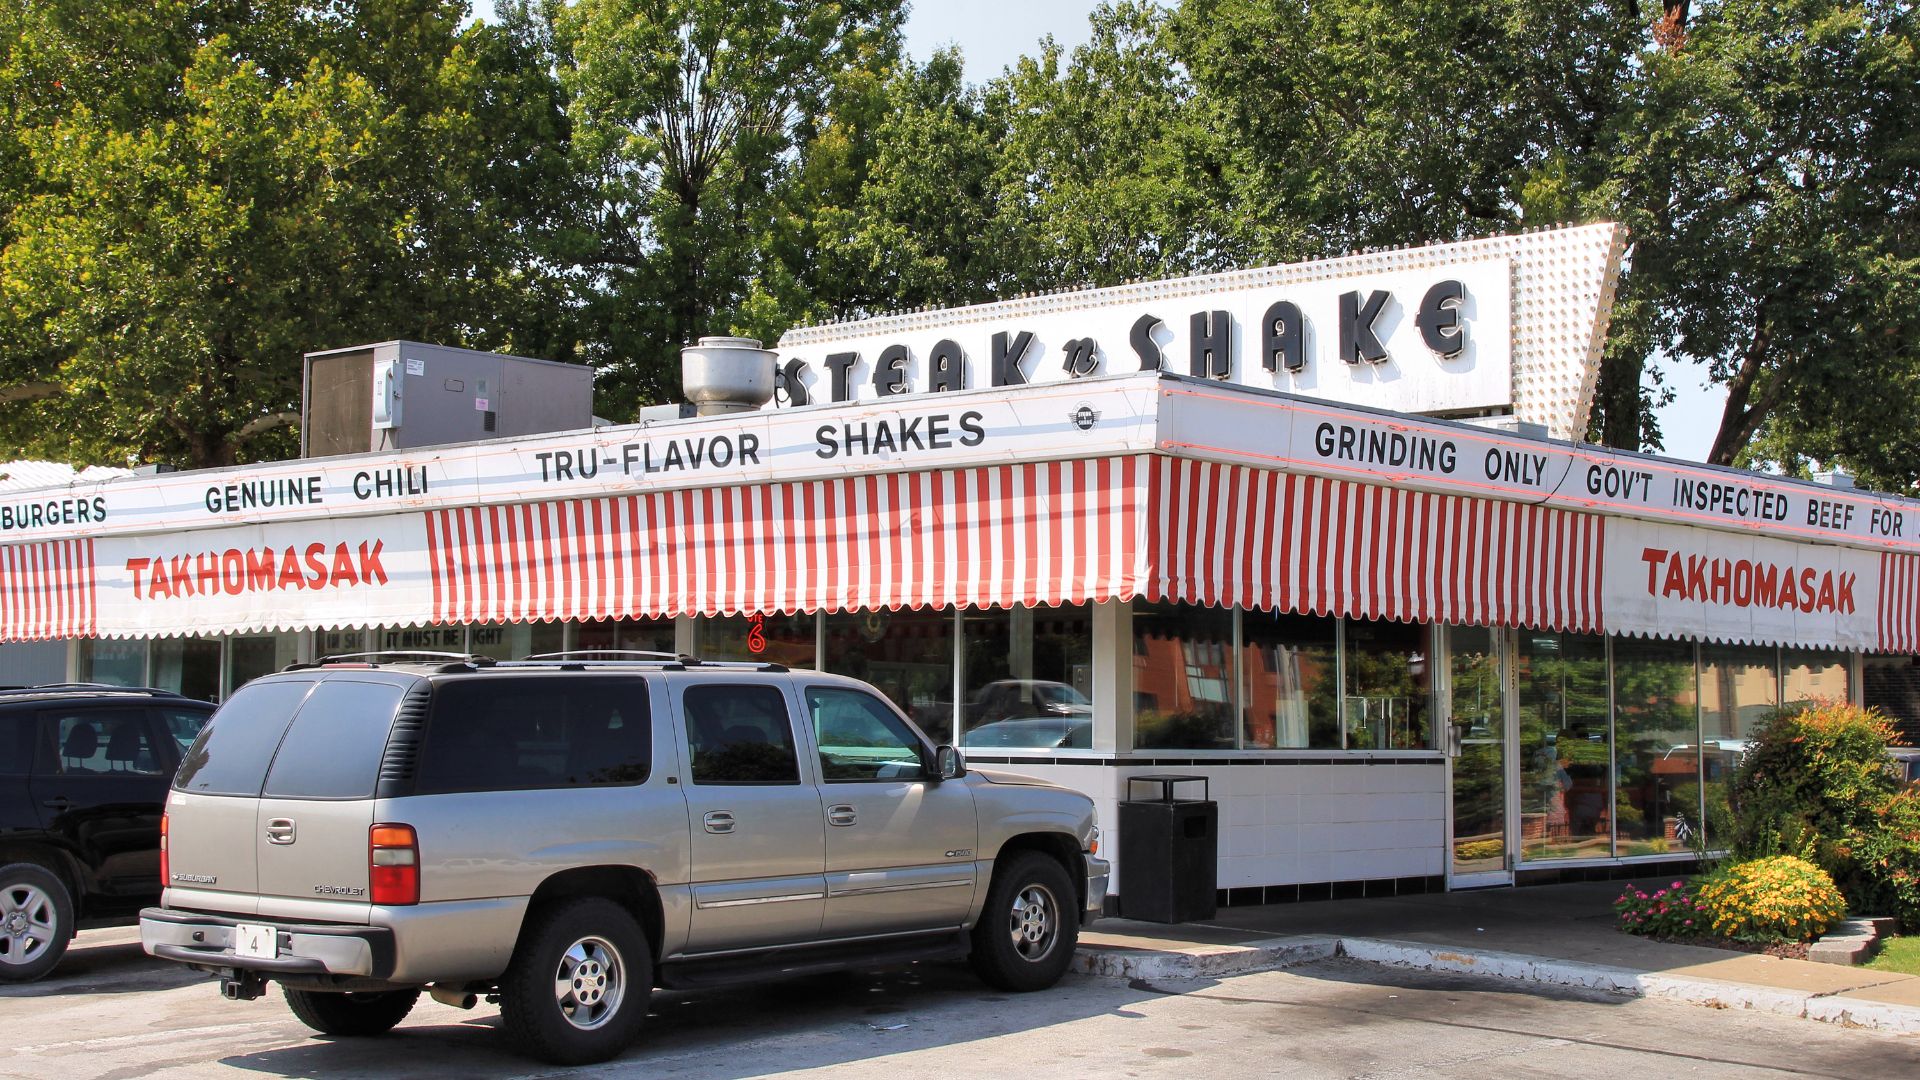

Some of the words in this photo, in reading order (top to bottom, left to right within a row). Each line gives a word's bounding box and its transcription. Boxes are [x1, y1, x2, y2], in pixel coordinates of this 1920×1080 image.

[784, 331, 1035, 407] STEAK
[1129, 279, 1466, 379] SHAKE
[0, 497, 107, 530] BURGERS
[205, 476, 323, 513] GENUINE
[353, 465, 428, 500] CHILI
[535, 433, 760, 482] TRU-FLAVOR
[815, 411, 985, 459] SHAKES
[1315, 422, 1457, 474] GRINDING
[1484, 447, 1547, 487] ONLY
[1586, 464, 1653, 502] GOV'T
[1673, 477, 1789, 522] INSPECTED
[1806, 498, 1855, 530] BEEF
[1870, 508, 1903, 538] FOR
[126, 539, 389, 600] TAKHOMASAK
[1641, 547, 1857, 614] TAKHOMASAK
[386, 631, 399, 648] IT
[402, 629, 440, 647] MUST
[443, 628, 459, 646] BE
[463, 627, 504, 646] IGHT
[747, 623, 766, 653] 6
[178, 873, 217, 884] SUBURBAN
[314, 884, 365, 896] CHEVROLET
[250, 935, 258, 953] 4
